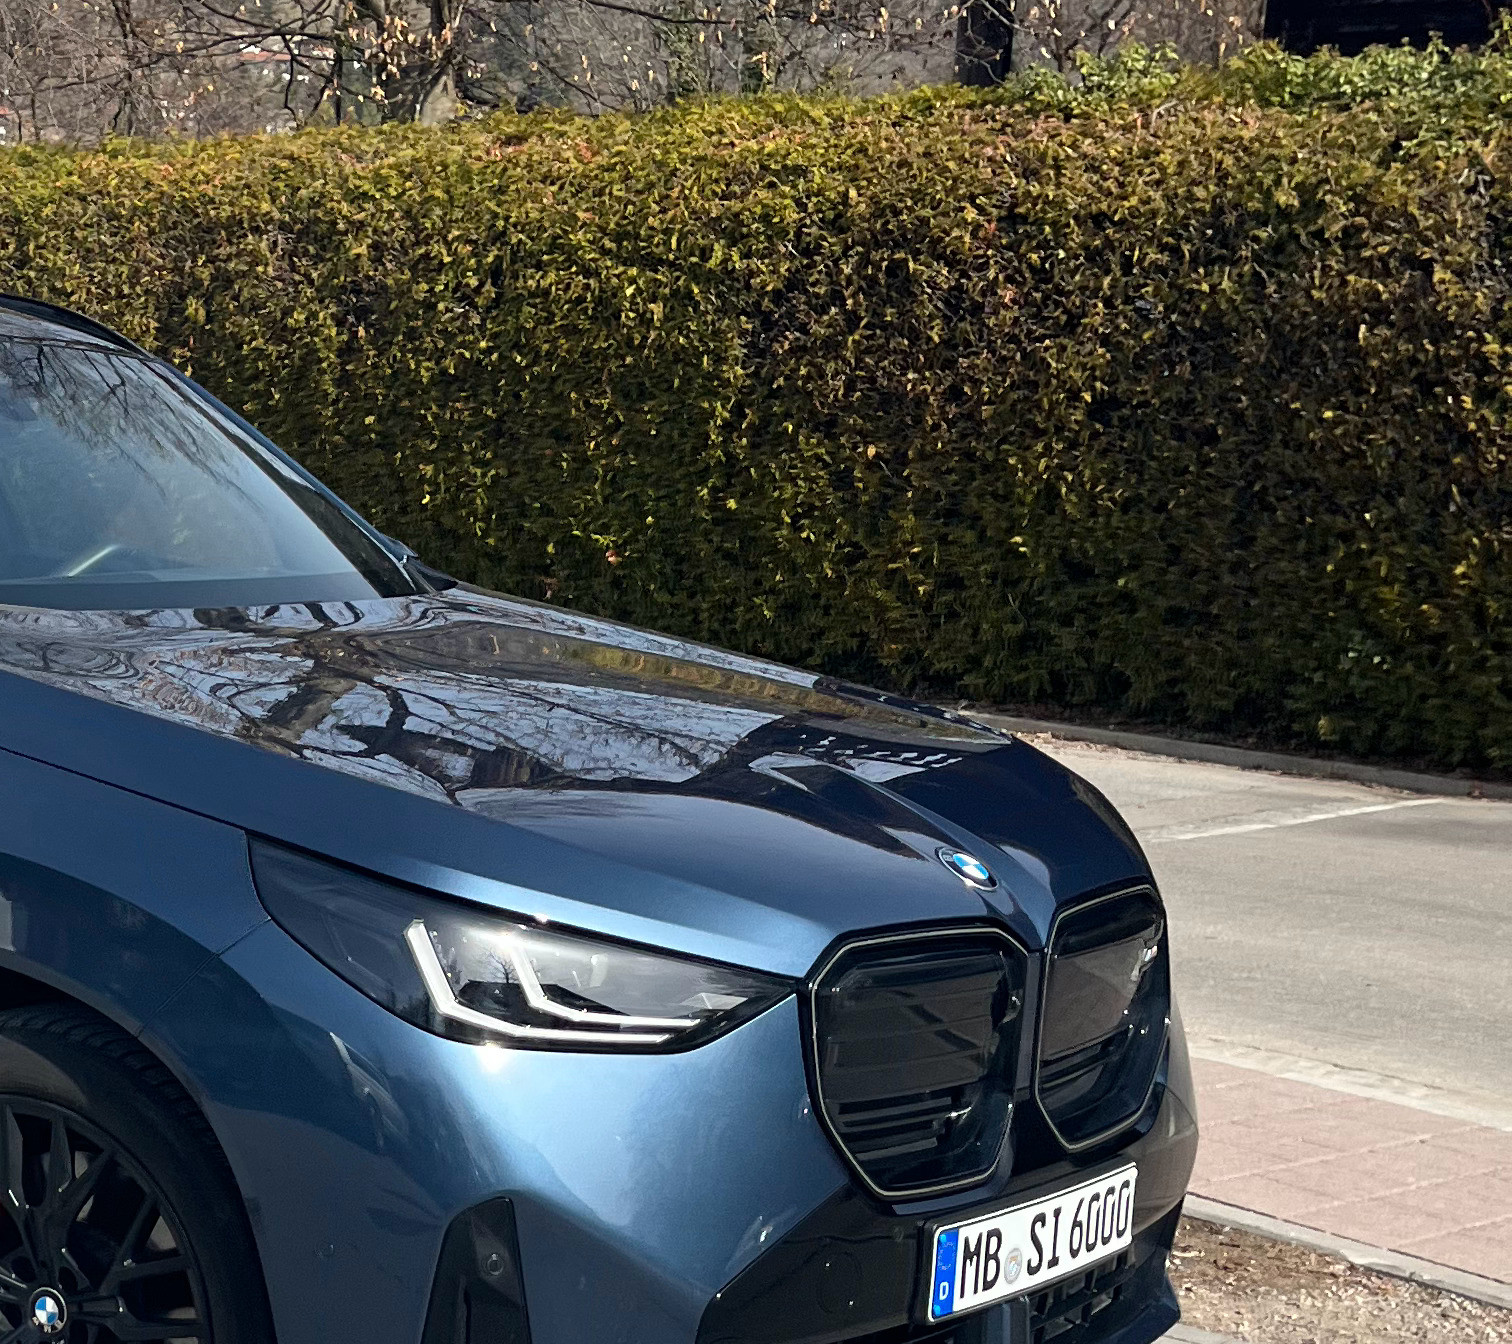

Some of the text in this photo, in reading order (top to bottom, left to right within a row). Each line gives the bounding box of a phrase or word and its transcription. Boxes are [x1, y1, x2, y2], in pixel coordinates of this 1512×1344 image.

[959, 1179, 1131, 1299] MB SI 6000
[939, 1281, 949, 1301] D
